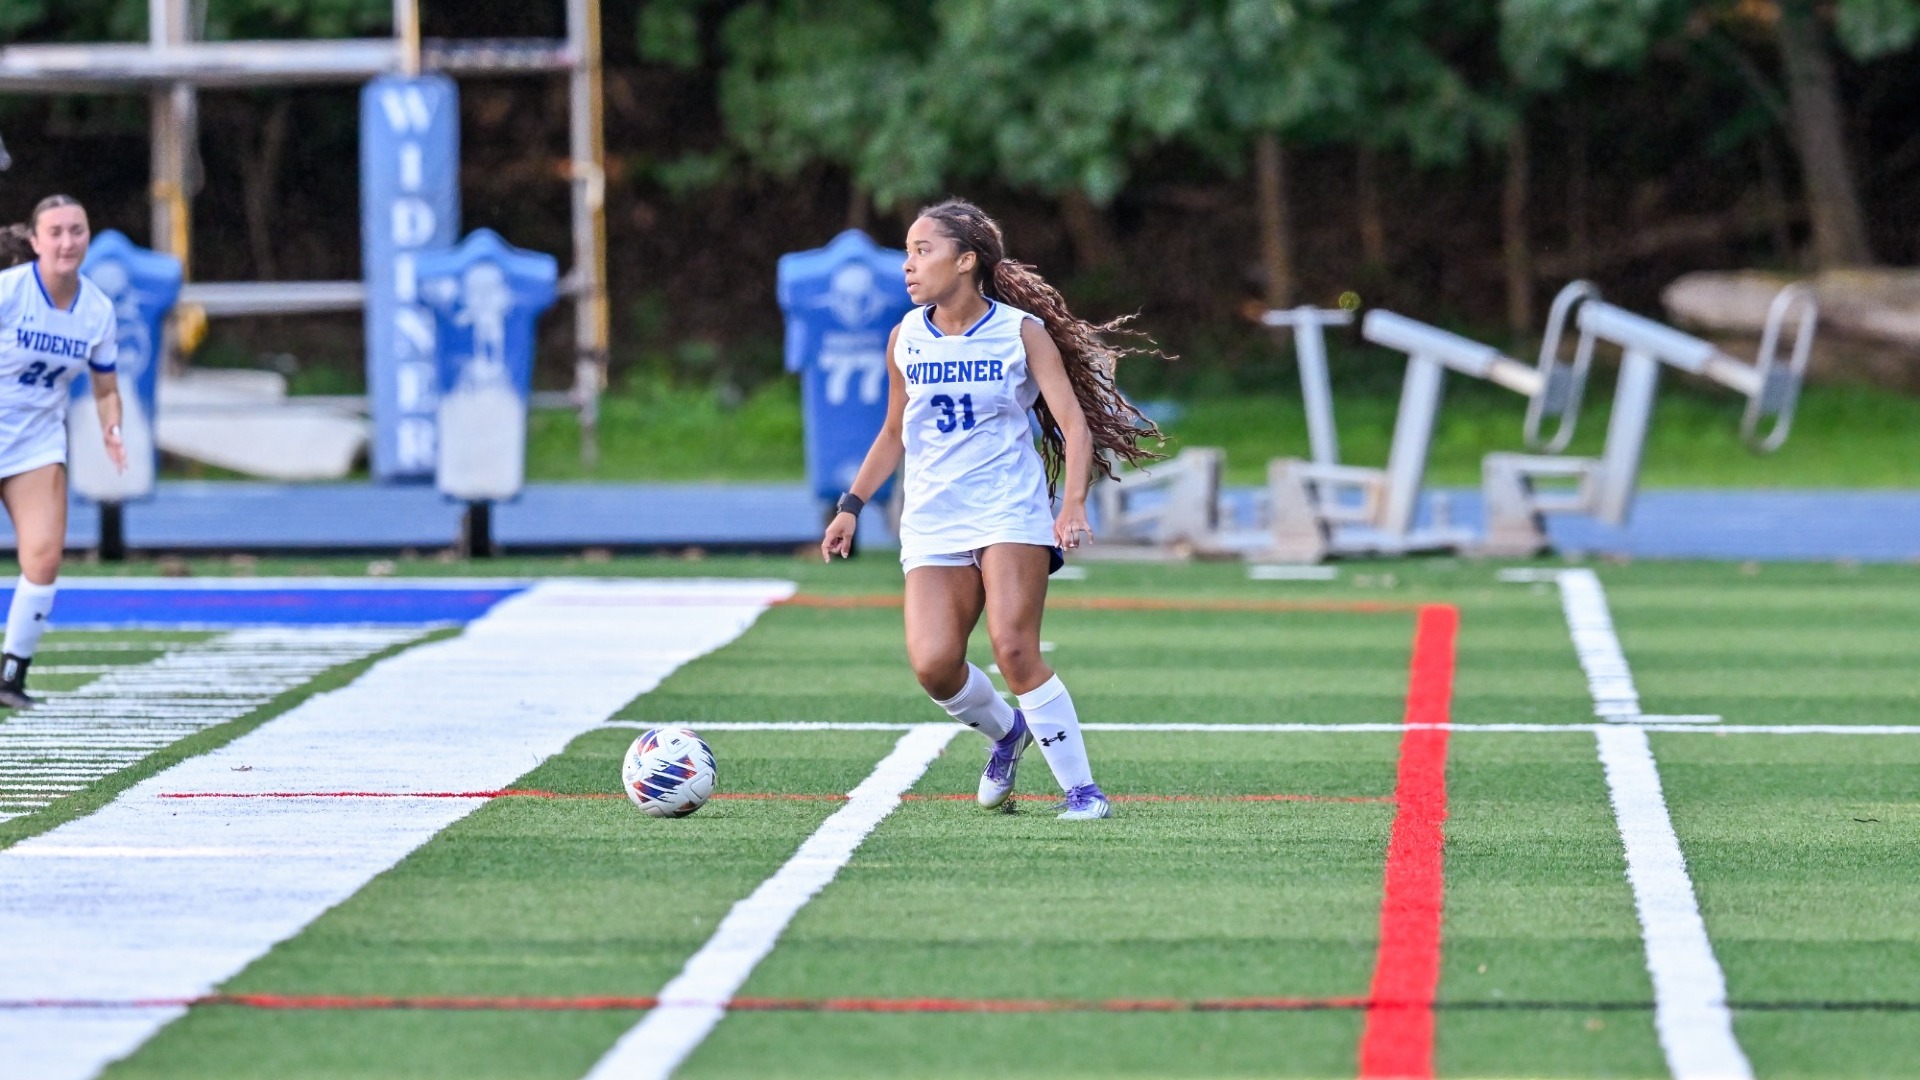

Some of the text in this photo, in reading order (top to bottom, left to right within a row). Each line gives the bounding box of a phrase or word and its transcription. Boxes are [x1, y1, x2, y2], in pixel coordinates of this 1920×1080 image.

[819, 352, 886, 405] 77
[906, 360, 1003, 385] WIDENER
[930, 393, 976, 433] 31
